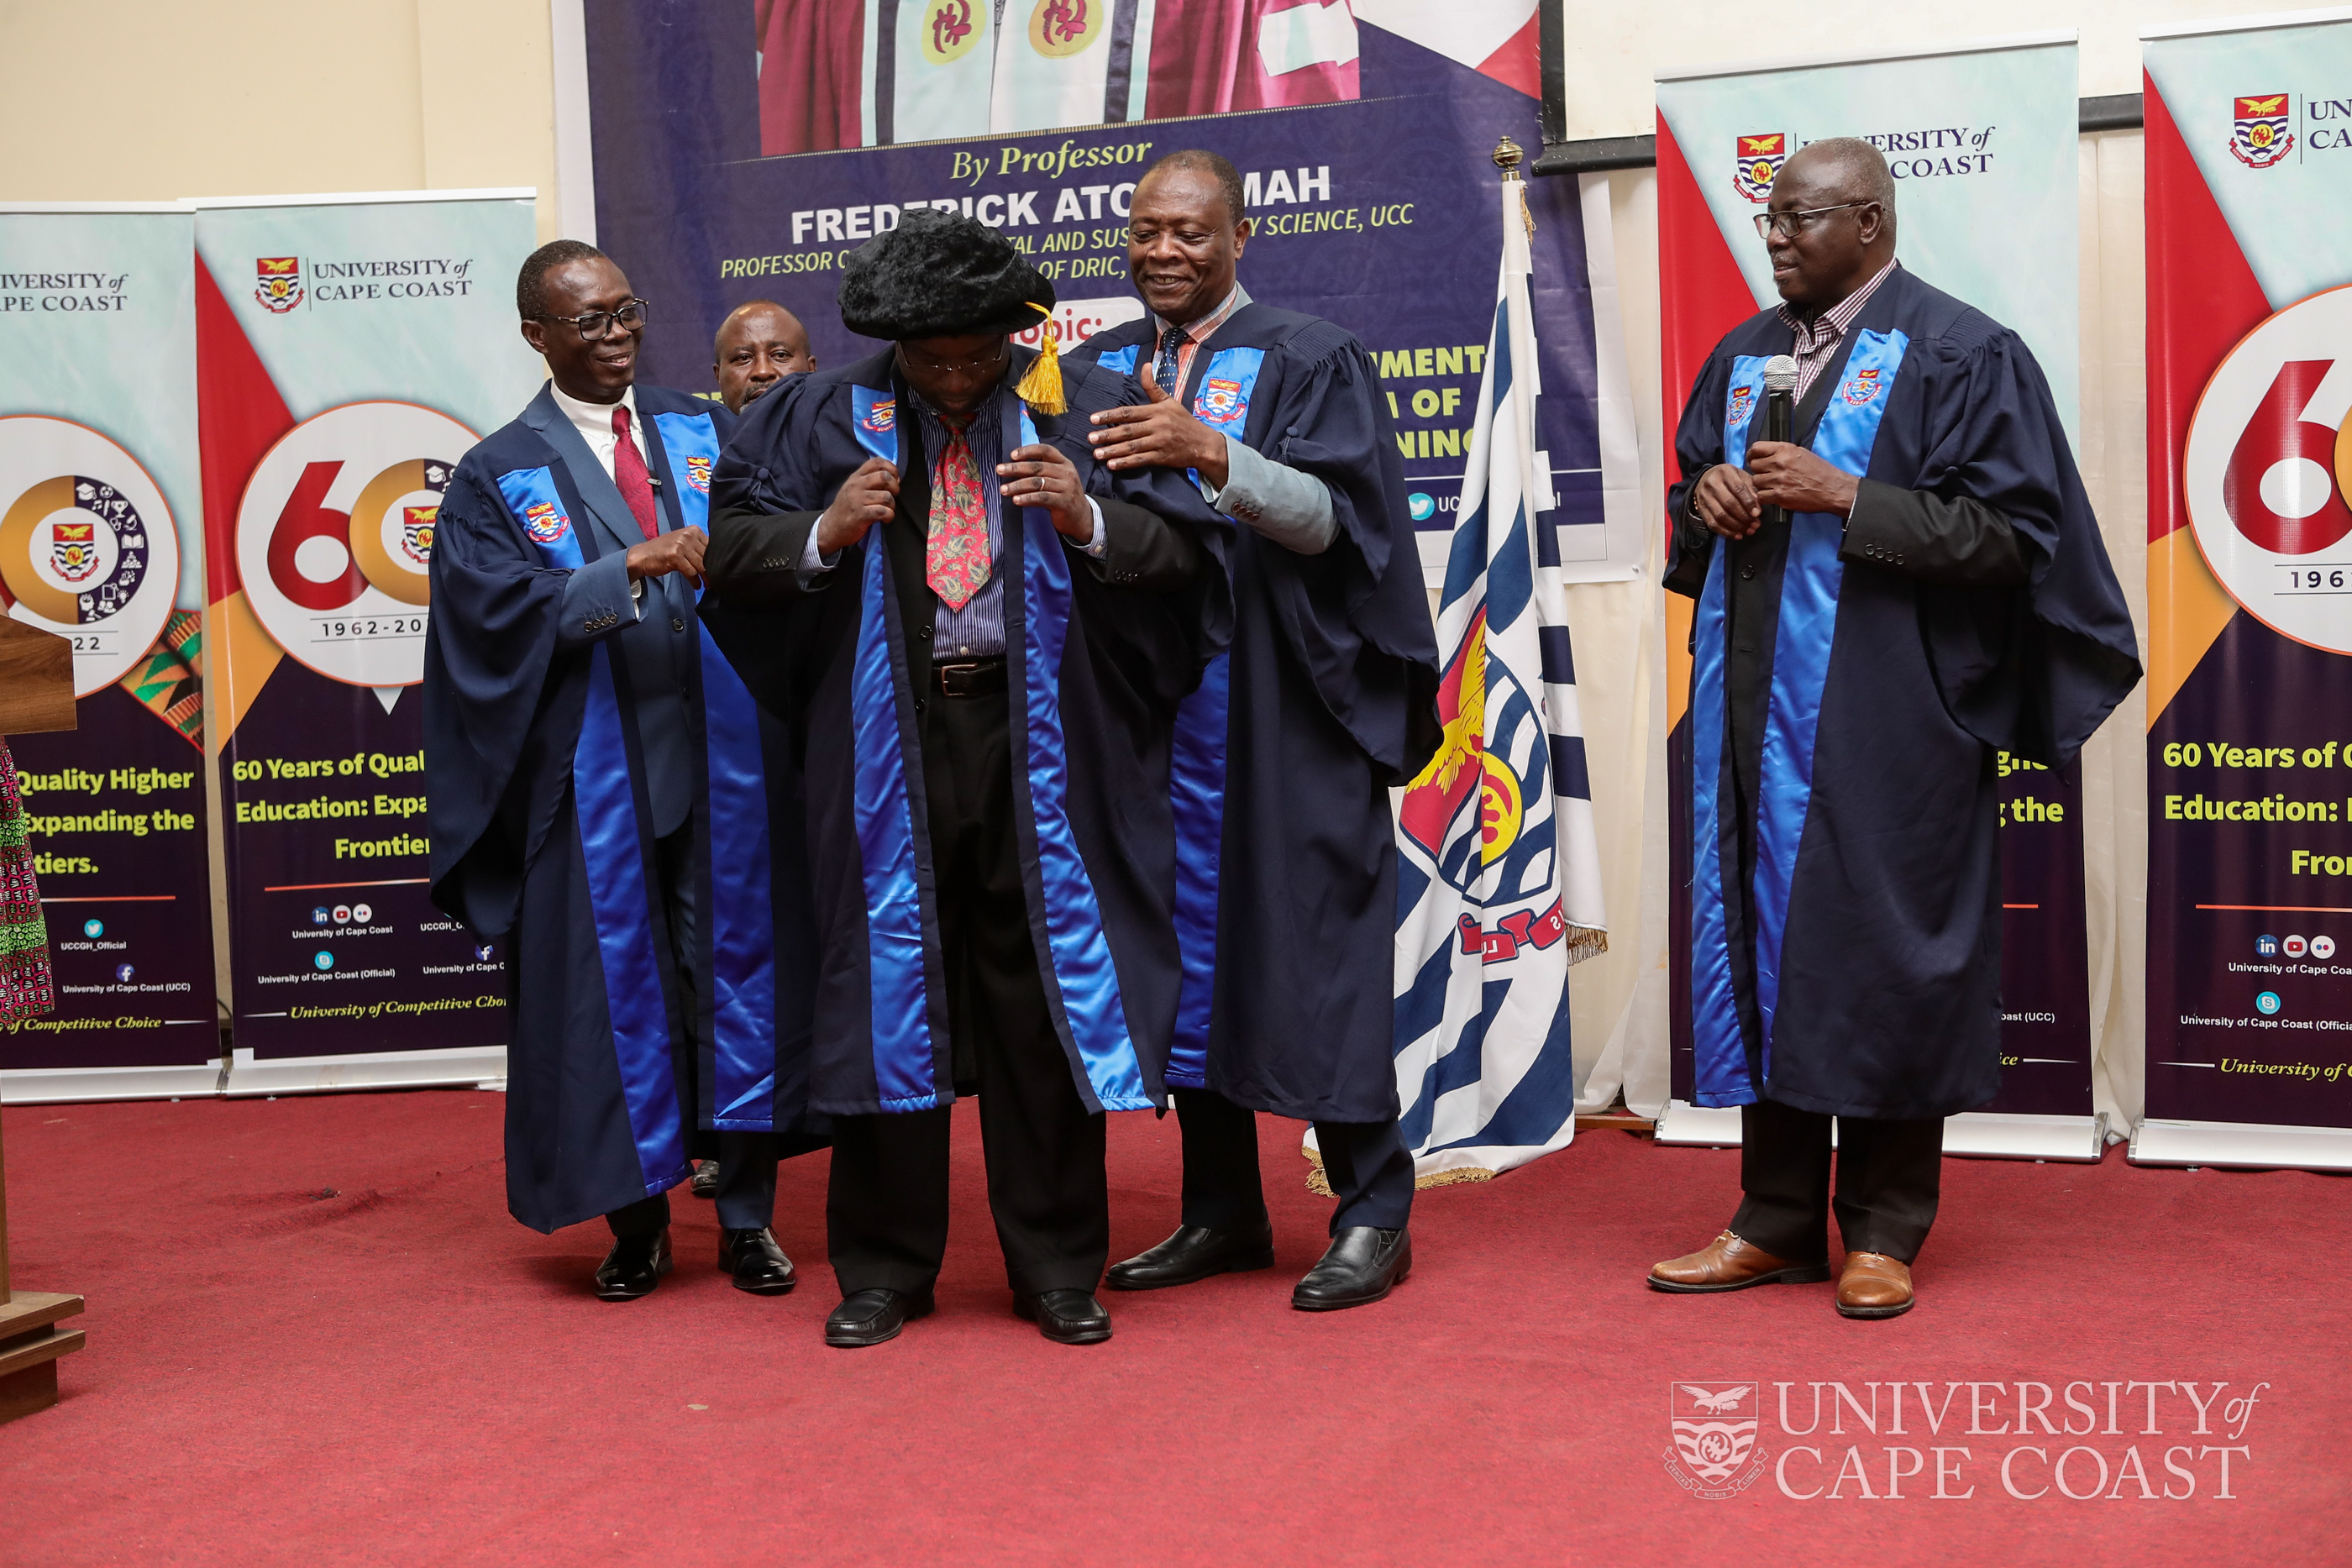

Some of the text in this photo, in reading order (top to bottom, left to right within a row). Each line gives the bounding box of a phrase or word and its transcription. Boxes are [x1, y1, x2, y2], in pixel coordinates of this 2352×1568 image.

[1971, 126, 1996, 152] of
[950, 139, 1152, 186] By Professor
[1265, 208, 1363, 236] SCIENCE,
[1370, 203, 1415, 228] UCC
[1041, 231, 1086, 254] AND
[313, 259, 474, 279] UNIVERSITY of
[721, 251, 832, 279] PROFESSOR
[1071, 255, 1126, 280] DRIC,
[108, 274, 129, 294] of
[316, 280, 473, 301] CAPE COAST
[42, 295, 128, 312] COAST
[1411, 387, 1461, 417] OF
[2163, 742, 2202, 768] 60
[2207, 742, 2296, 768] Years
[2302, 741, 2338, 768] of
[233, 759, 263, 781] 60
[266, 758, 334, 779] Years
[338, 753, 365, 775] of
[16, 767, 195, 796] Quality Higher
[236, 795, 369, 822] Education:
[2011, 796, 2064, 822] the
[2165, 794, 2339, 822] Education:
[151, 809, 195, 831] the
[292, 926, 393, 939] University of Cape Coast
[60, 941, 127, 952] UCCGH_Official
[258, 968, 396, 984] University of Cape Coast (Official)
[423, 965, 465, 974] University
[466, 963, 475, 972] of
[476, 962, 497, 973] Cape
[2229, 962, 2283, 975] University
[2286, 963, 2297, 973] of
[2299, 964, 2328, 976] Cape
[62, 983, 191, 994] University of Cape Coast (UCC)
[290, 1004, 368, 1020] University
[368, 1001, 386, 1018] of
[386, 997, 472, 1015] Competitive
[2024, 1011, 2055, 1024] (UCC)
[24, 1018, 113, 1034] Competitive
[114, 1016, 161, 1030] Choice
[2180, 1015, 2234, 1028] University
[2237, 1017, 2248, 1027] of
[2250, 1017, 2278, 1030] Cape
[2281, 1019, 2313, 1030] Coast
[2220, 1057, 2320, 1081] University
[2323, 1062, 2348, 1083] of
